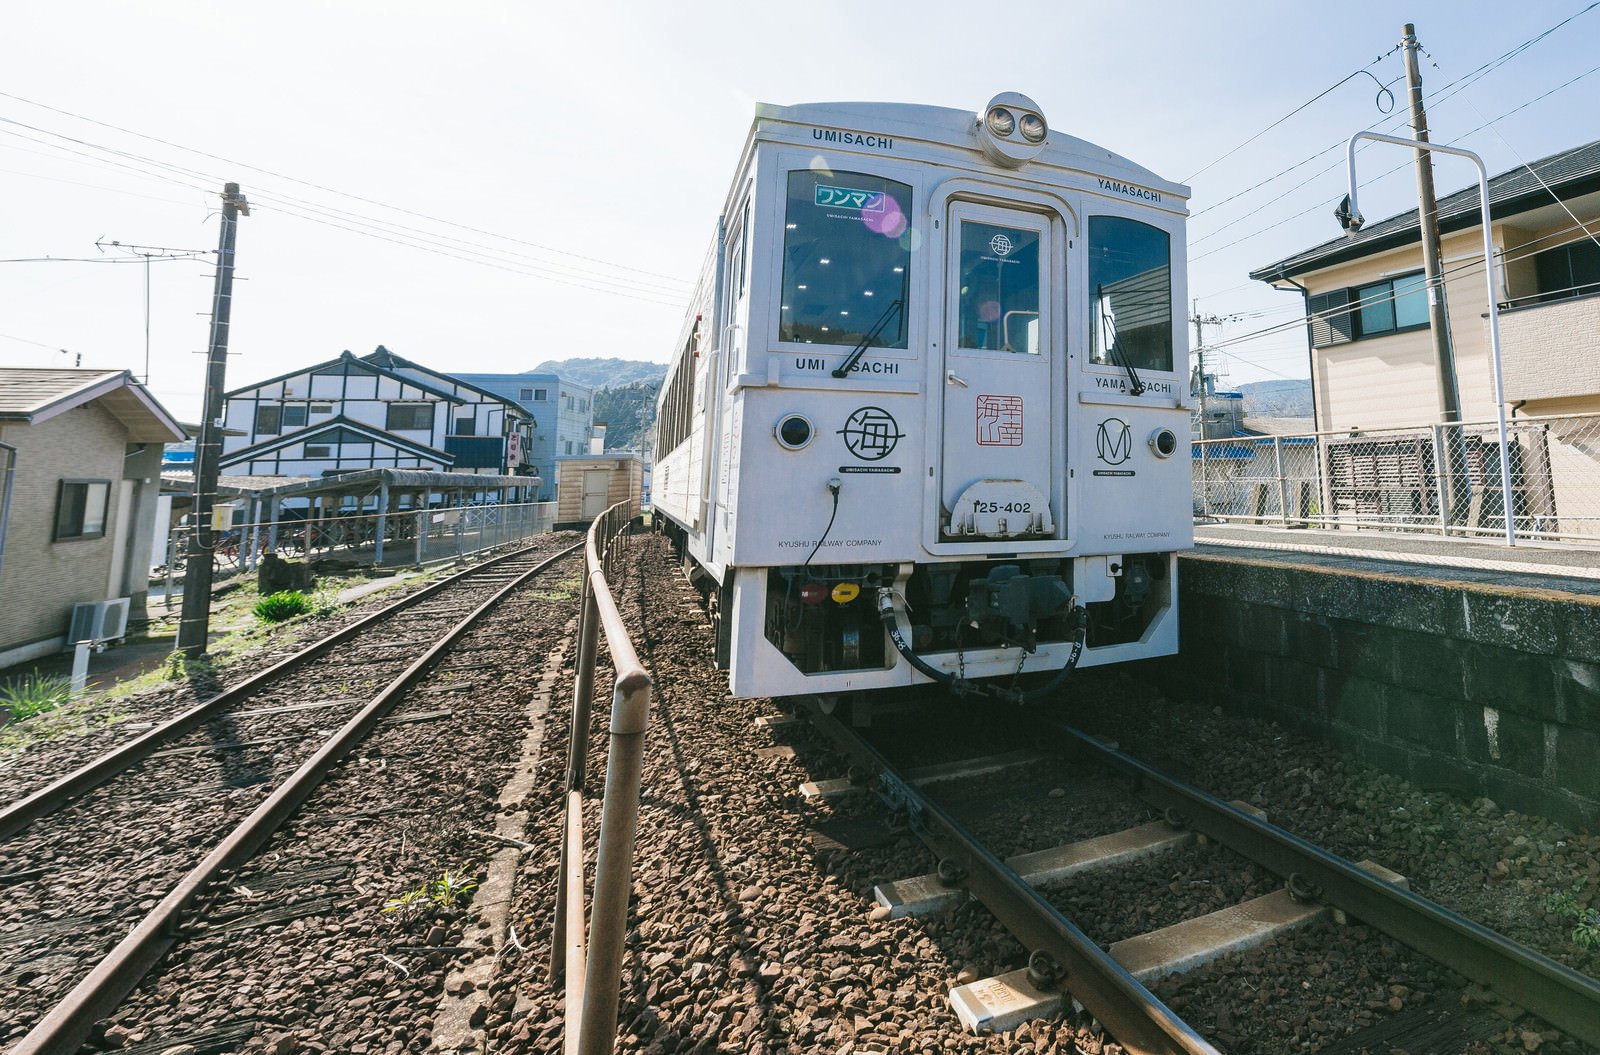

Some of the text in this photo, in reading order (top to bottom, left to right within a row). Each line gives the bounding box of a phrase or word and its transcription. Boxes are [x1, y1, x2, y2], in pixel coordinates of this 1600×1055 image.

[812, 128, 893, 150] UMISACHI
[818, 188, 883, 209] ワンマン
[1097, 178, 1162, 203] YAMASACHI
[795, 358, 899, 374] UMI SACHI
[1095, 377, 1171, 394] YAMA SACHI
[846, 539, 882, 547] COMPANY
